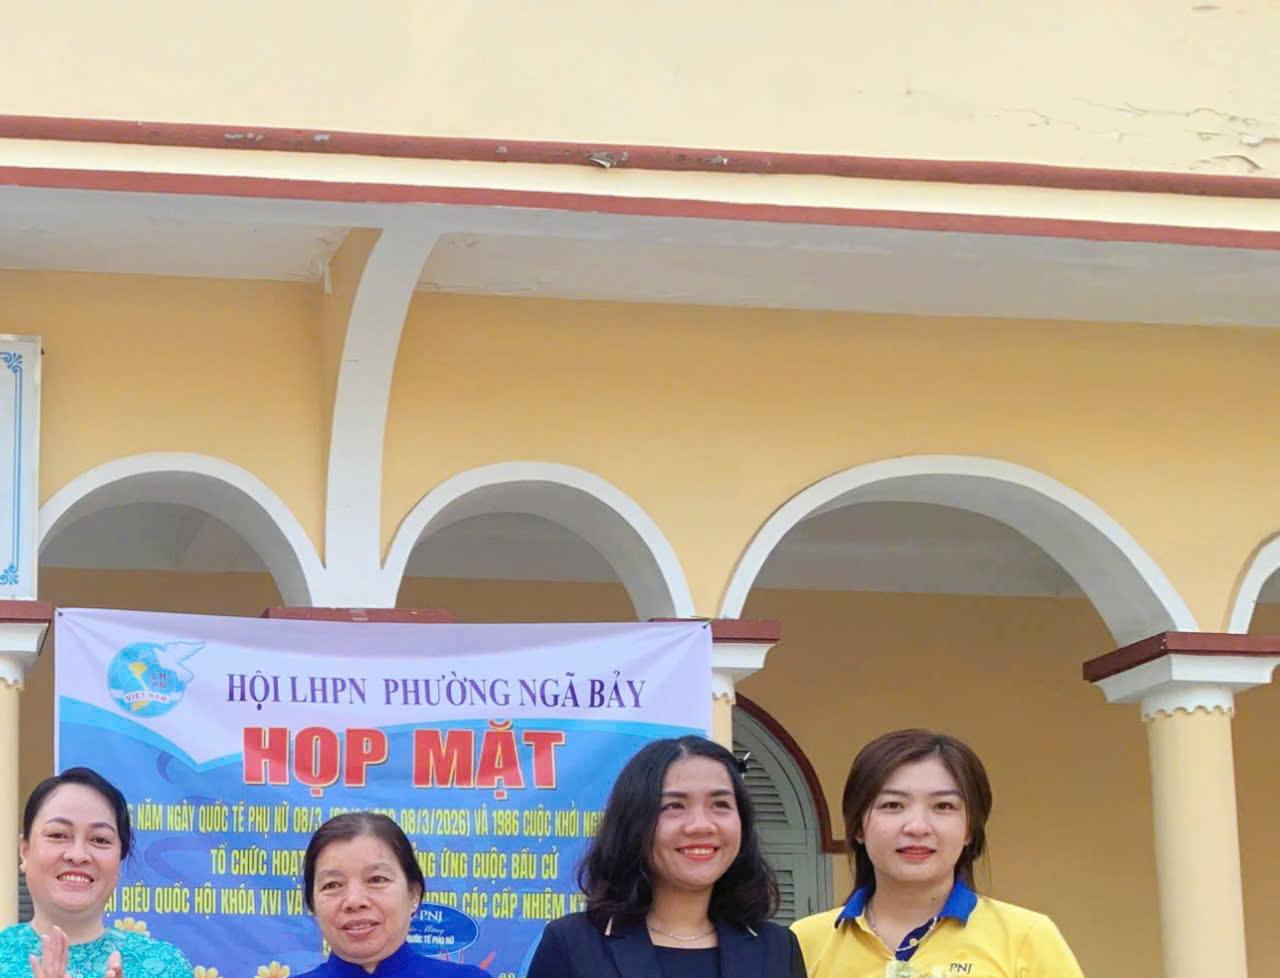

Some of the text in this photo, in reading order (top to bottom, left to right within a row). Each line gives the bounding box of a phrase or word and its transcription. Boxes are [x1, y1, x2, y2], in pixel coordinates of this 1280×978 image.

[226, 670, 645, 710] HỘI LHPN PHƯỜNG NGÃ BẢY
[243, 719, 566, 800] HỌP MẶT
[137, 797, 163, 831] NĂM
[167, 798, 196, 832] NGÀY
[199, 797, 228, 834] QUỐC
[233, 796, 246, 833] TẾ
[249, 804, 270, 839] PHỤ
[274, 801, 289, 833] NỮ
[475, 803, 489, 836] VÀ
[523, 804, 551, 842] CUỘC
[555, 799, 580, 838] KHỞI
[210, 843, 227, 876] TỔ
[231, 844, 268, 876] CHỨC
[440, 847, 468, 879] ỨNG
[472, 846, 507, 884] CUỘC
[511, 848, 536, 880] BẦU
[541, 846, 559, 880] CỬ
[122, 879, 150, 913] BIỂU
[154, 880, 190, 914] QUỐC
[195, 881, 216, 919] HỘI
[221, 881, 255, 915] KHÓA
[260, 888, 282, 915] XVI
[286, 884, 304, 915] VÀ
[462, 885, 488, 918] CÁC
[492, 885, 518, 919] CẤP
[420, 910, 442, 924] PNJ
[949, 963, 972, 975] PNJ
